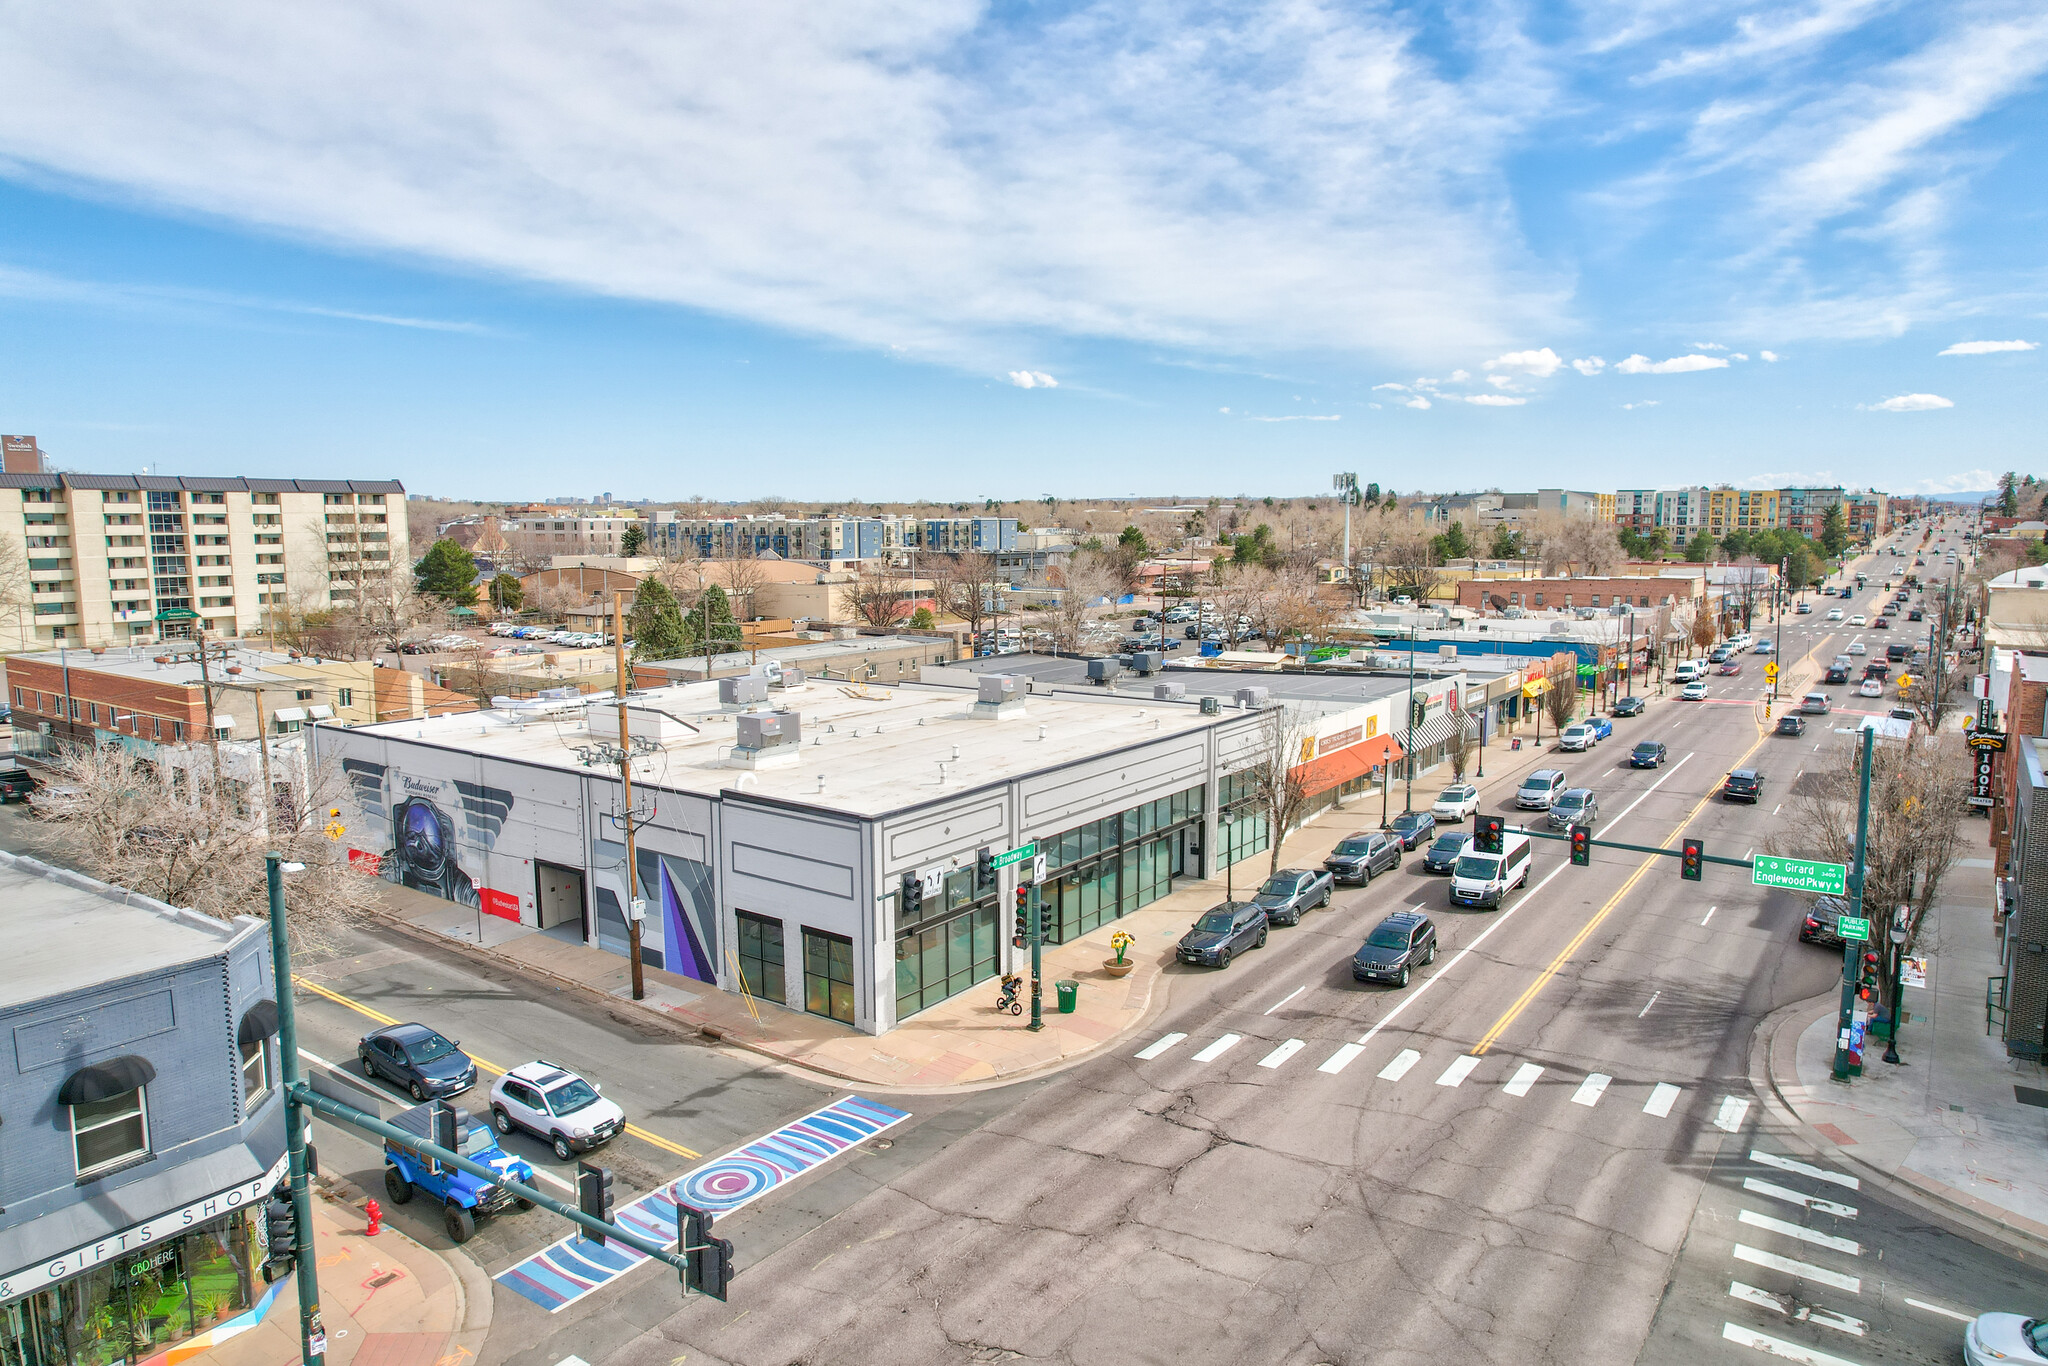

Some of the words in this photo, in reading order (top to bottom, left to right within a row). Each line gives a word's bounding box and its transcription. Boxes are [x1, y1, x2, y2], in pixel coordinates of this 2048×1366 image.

[1978, 753, 1991, 796] IOOF
[402, 775, 440, 794] Budweiser
[999, 850, 1023, 866] Broadway
[1785, 862, 1814, 875] Girard
[1756, 871, 1805, 887] Englewood
[1806, 877, 1832, 891] Pkwy
[1842, 924, 1866, 932] PARKING
[1844, 918, 1864, 926] PUBLIC
[0, 1281, 14, 1297] &
[48, 1226, 152, 1278] GIFTS
[182, 1182, 262, 1225] SHOP
[130, 1259, 151, 1277] CBD
[150, 1248, 175, 1269] HERE
